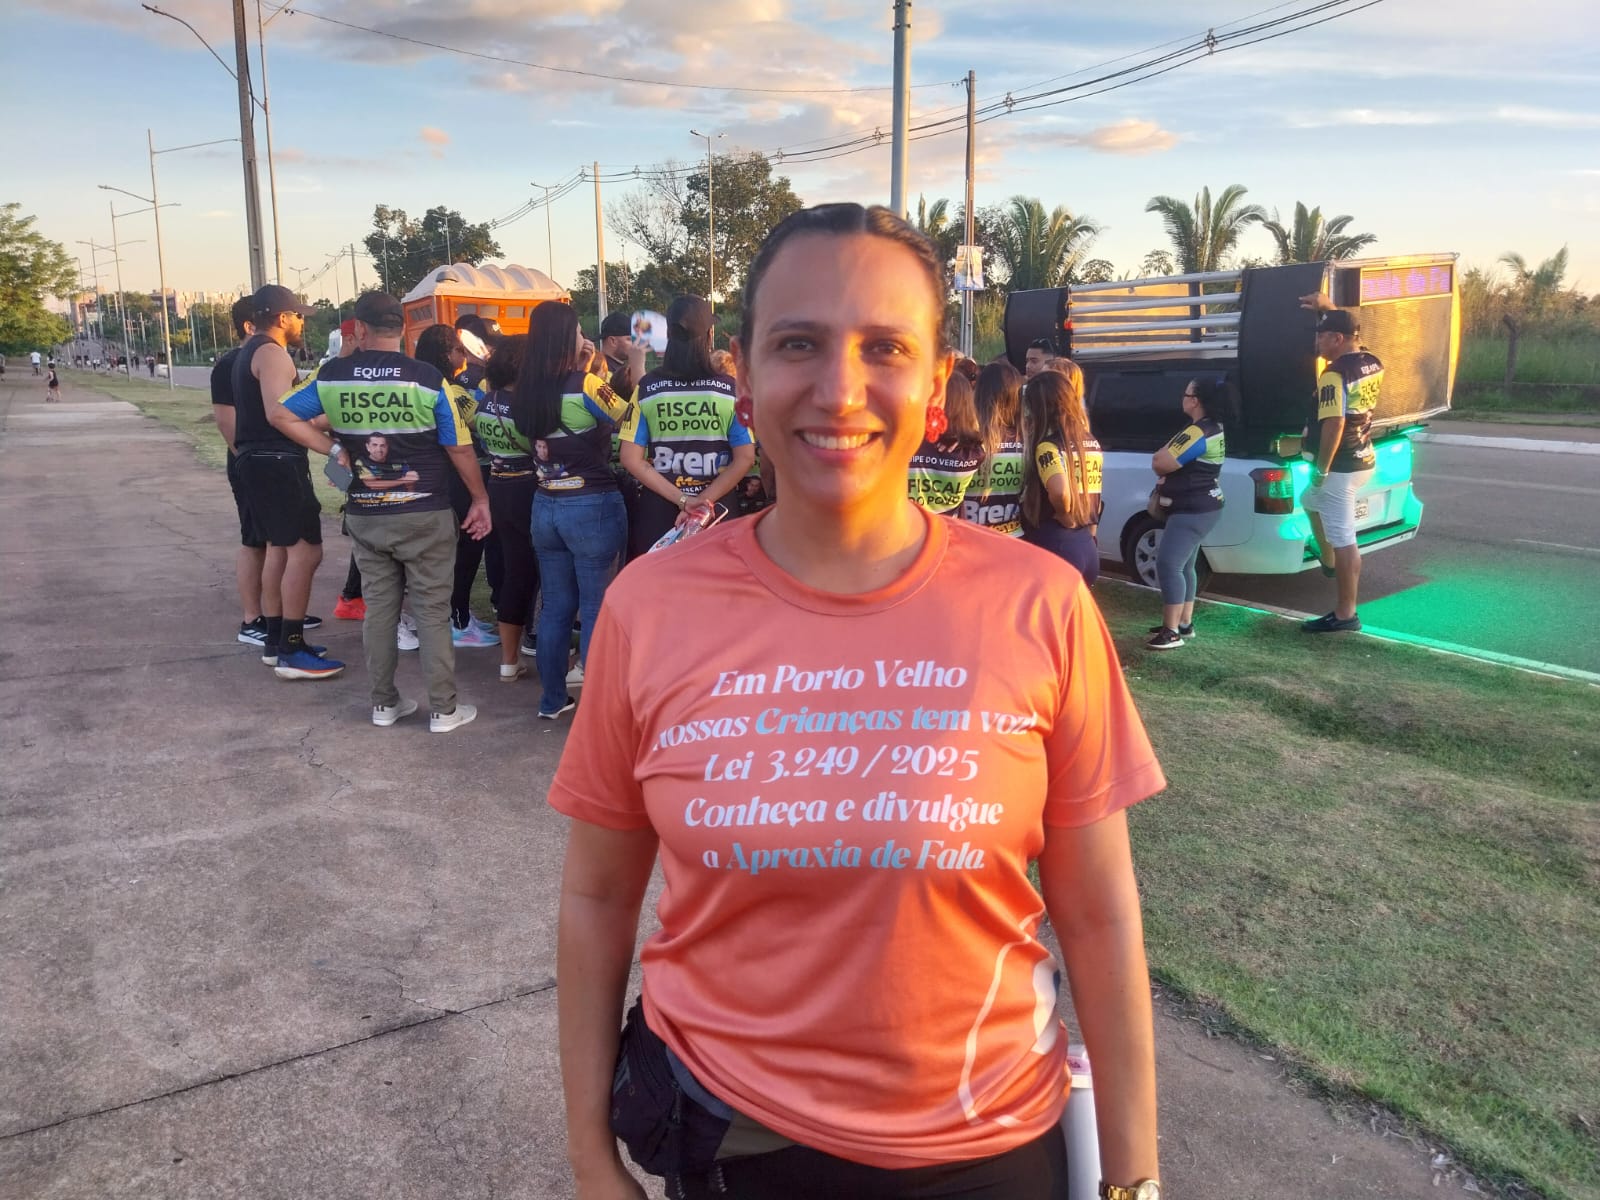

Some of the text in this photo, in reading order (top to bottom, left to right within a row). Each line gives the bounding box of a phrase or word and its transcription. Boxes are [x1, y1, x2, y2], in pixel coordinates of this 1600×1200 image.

[353, 367, 402, 379] EQUIPE
[646, 380, 673, 392] EQUIPE
[690, 379, 732, 391] VEREADOR
[339, 391, 414, 408] FISCAL
[341, 411, 415, 423] DO POVO
[656, 401, 720, 418] FISCAL
[658, 419, 721, 431] DO POVO
[925, 456, 937, 464] DO
[938, 458, 979, 468] VEREADOR
[907, 479, 963, 494] FISCAL
[989, 477, 1021, 487] POVO
[710, 660, 967, 697] Em Porto Velho
[755, 706, 904, 735] Crianças
[912, 704, 972, 732] tem
[703, 744, 980, 783] Lei 3.249 / 2025
[684, 791, 1005, 833] Conheça e divulgue
[702, 840, 985, 876] a Apraxia de Fala
